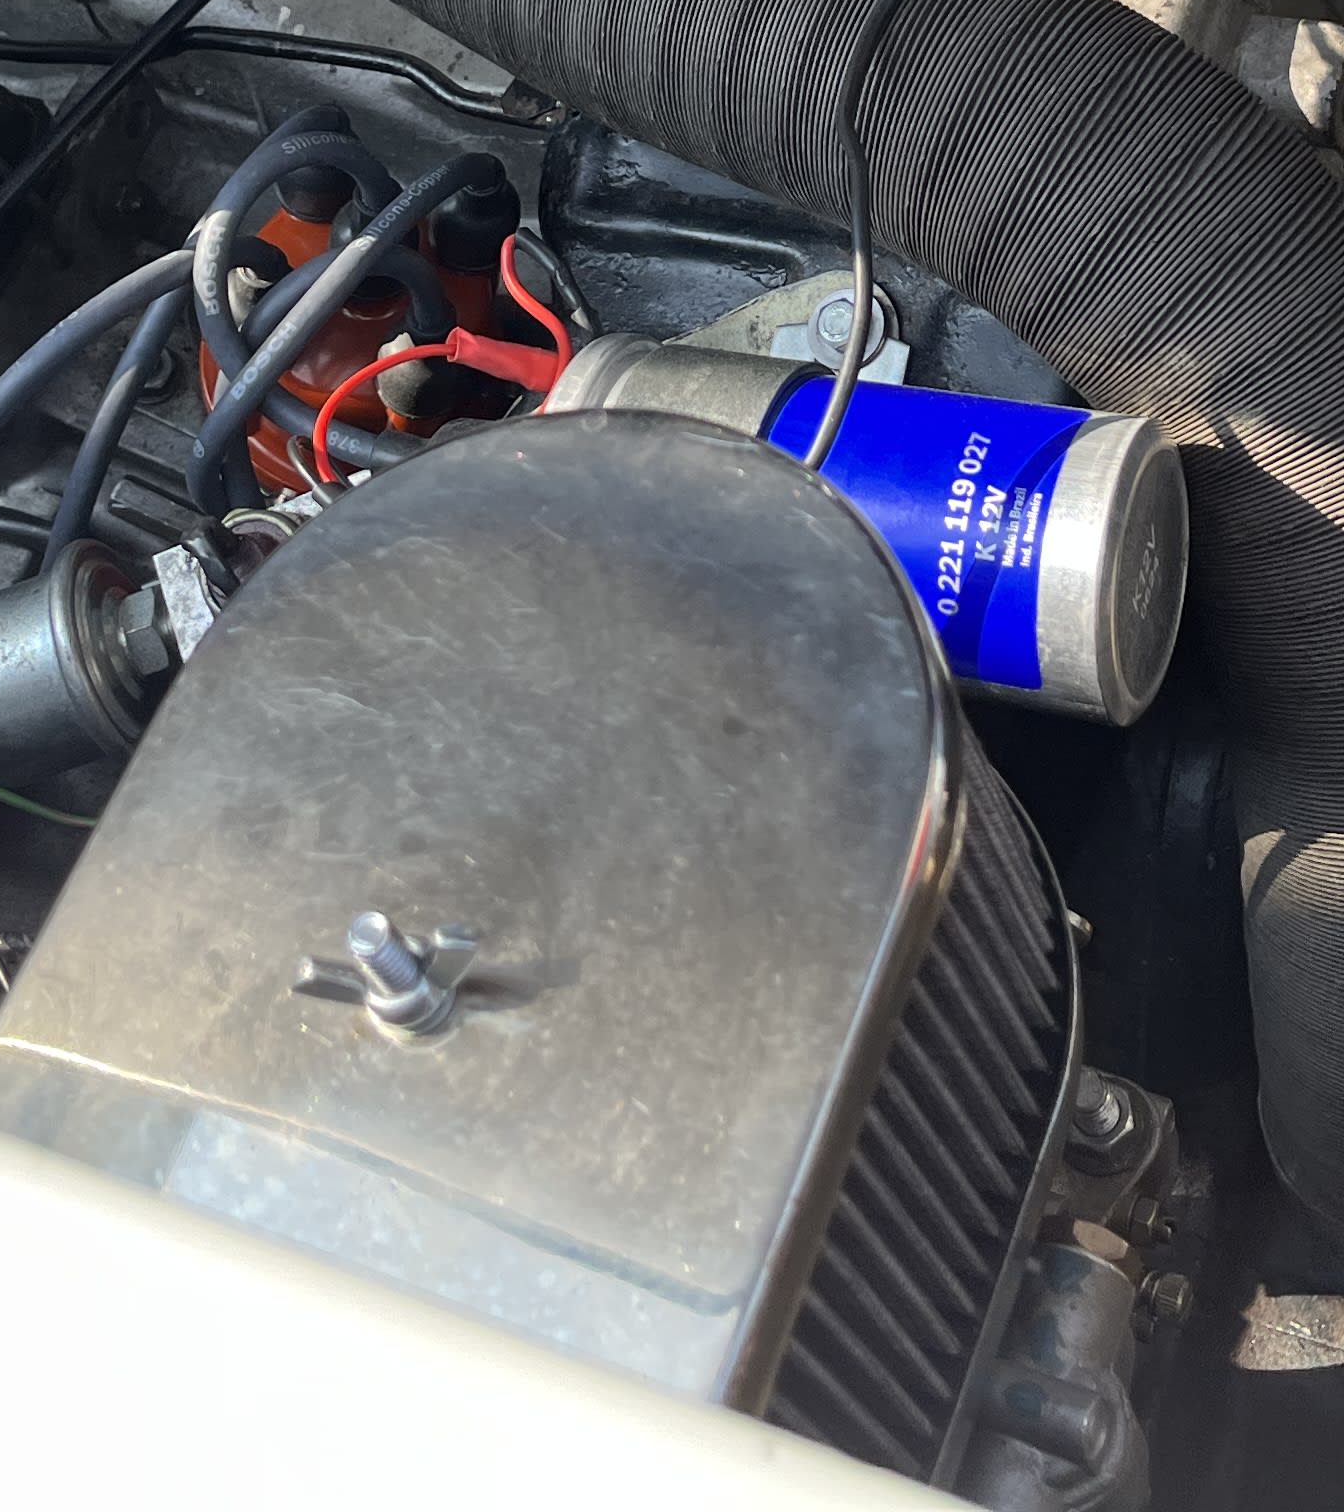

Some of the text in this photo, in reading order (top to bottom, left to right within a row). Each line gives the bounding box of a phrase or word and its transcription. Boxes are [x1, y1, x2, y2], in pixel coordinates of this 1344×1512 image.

[205, 224, 228, 317] BOSCH
[230, 322, 296, 401] BOSCH
[937, 431, 992, 616] 0 221 119 027
[974, 484, 1008, 562] K 12V
[1009, 487, 1027, 519] Brazil
[1002, 533, 1017, 567] Made
